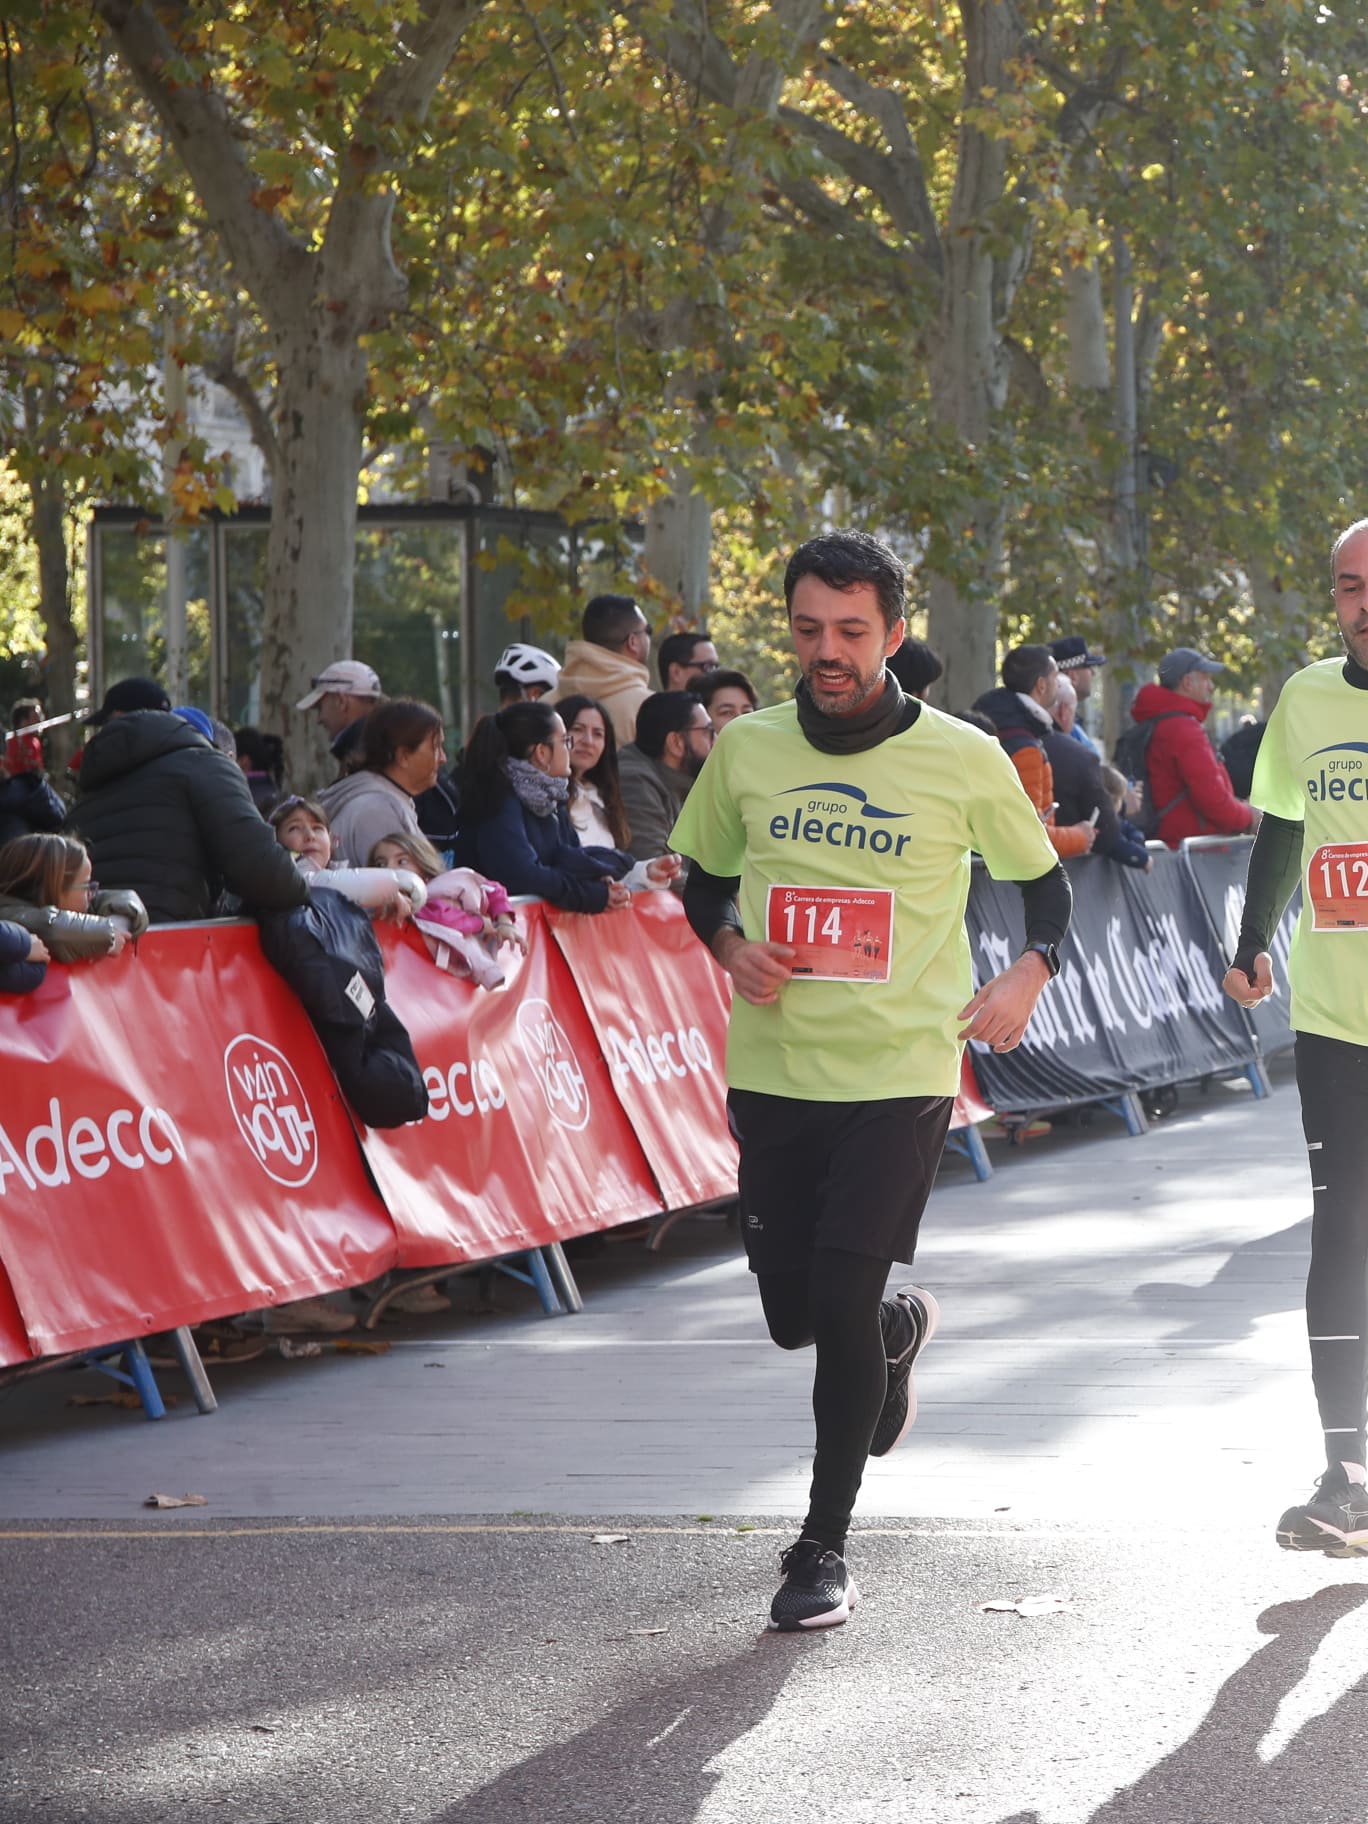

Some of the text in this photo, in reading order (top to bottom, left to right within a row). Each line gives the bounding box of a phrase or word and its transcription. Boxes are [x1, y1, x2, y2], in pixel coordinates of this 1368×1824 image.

[1328, 760, 1362, 772] grupo
[807, 800, 847, 815] grupo
[769, 808, 911, 857] elecnor
[852, 897, 875, 905] Adecco
[783, 904, 842, 944] 114
[606, 1019, 713, 1088] Adecco
[405, 1058, 506, 1126] ecco
[0, 1097, 187, 1195] Adecco
